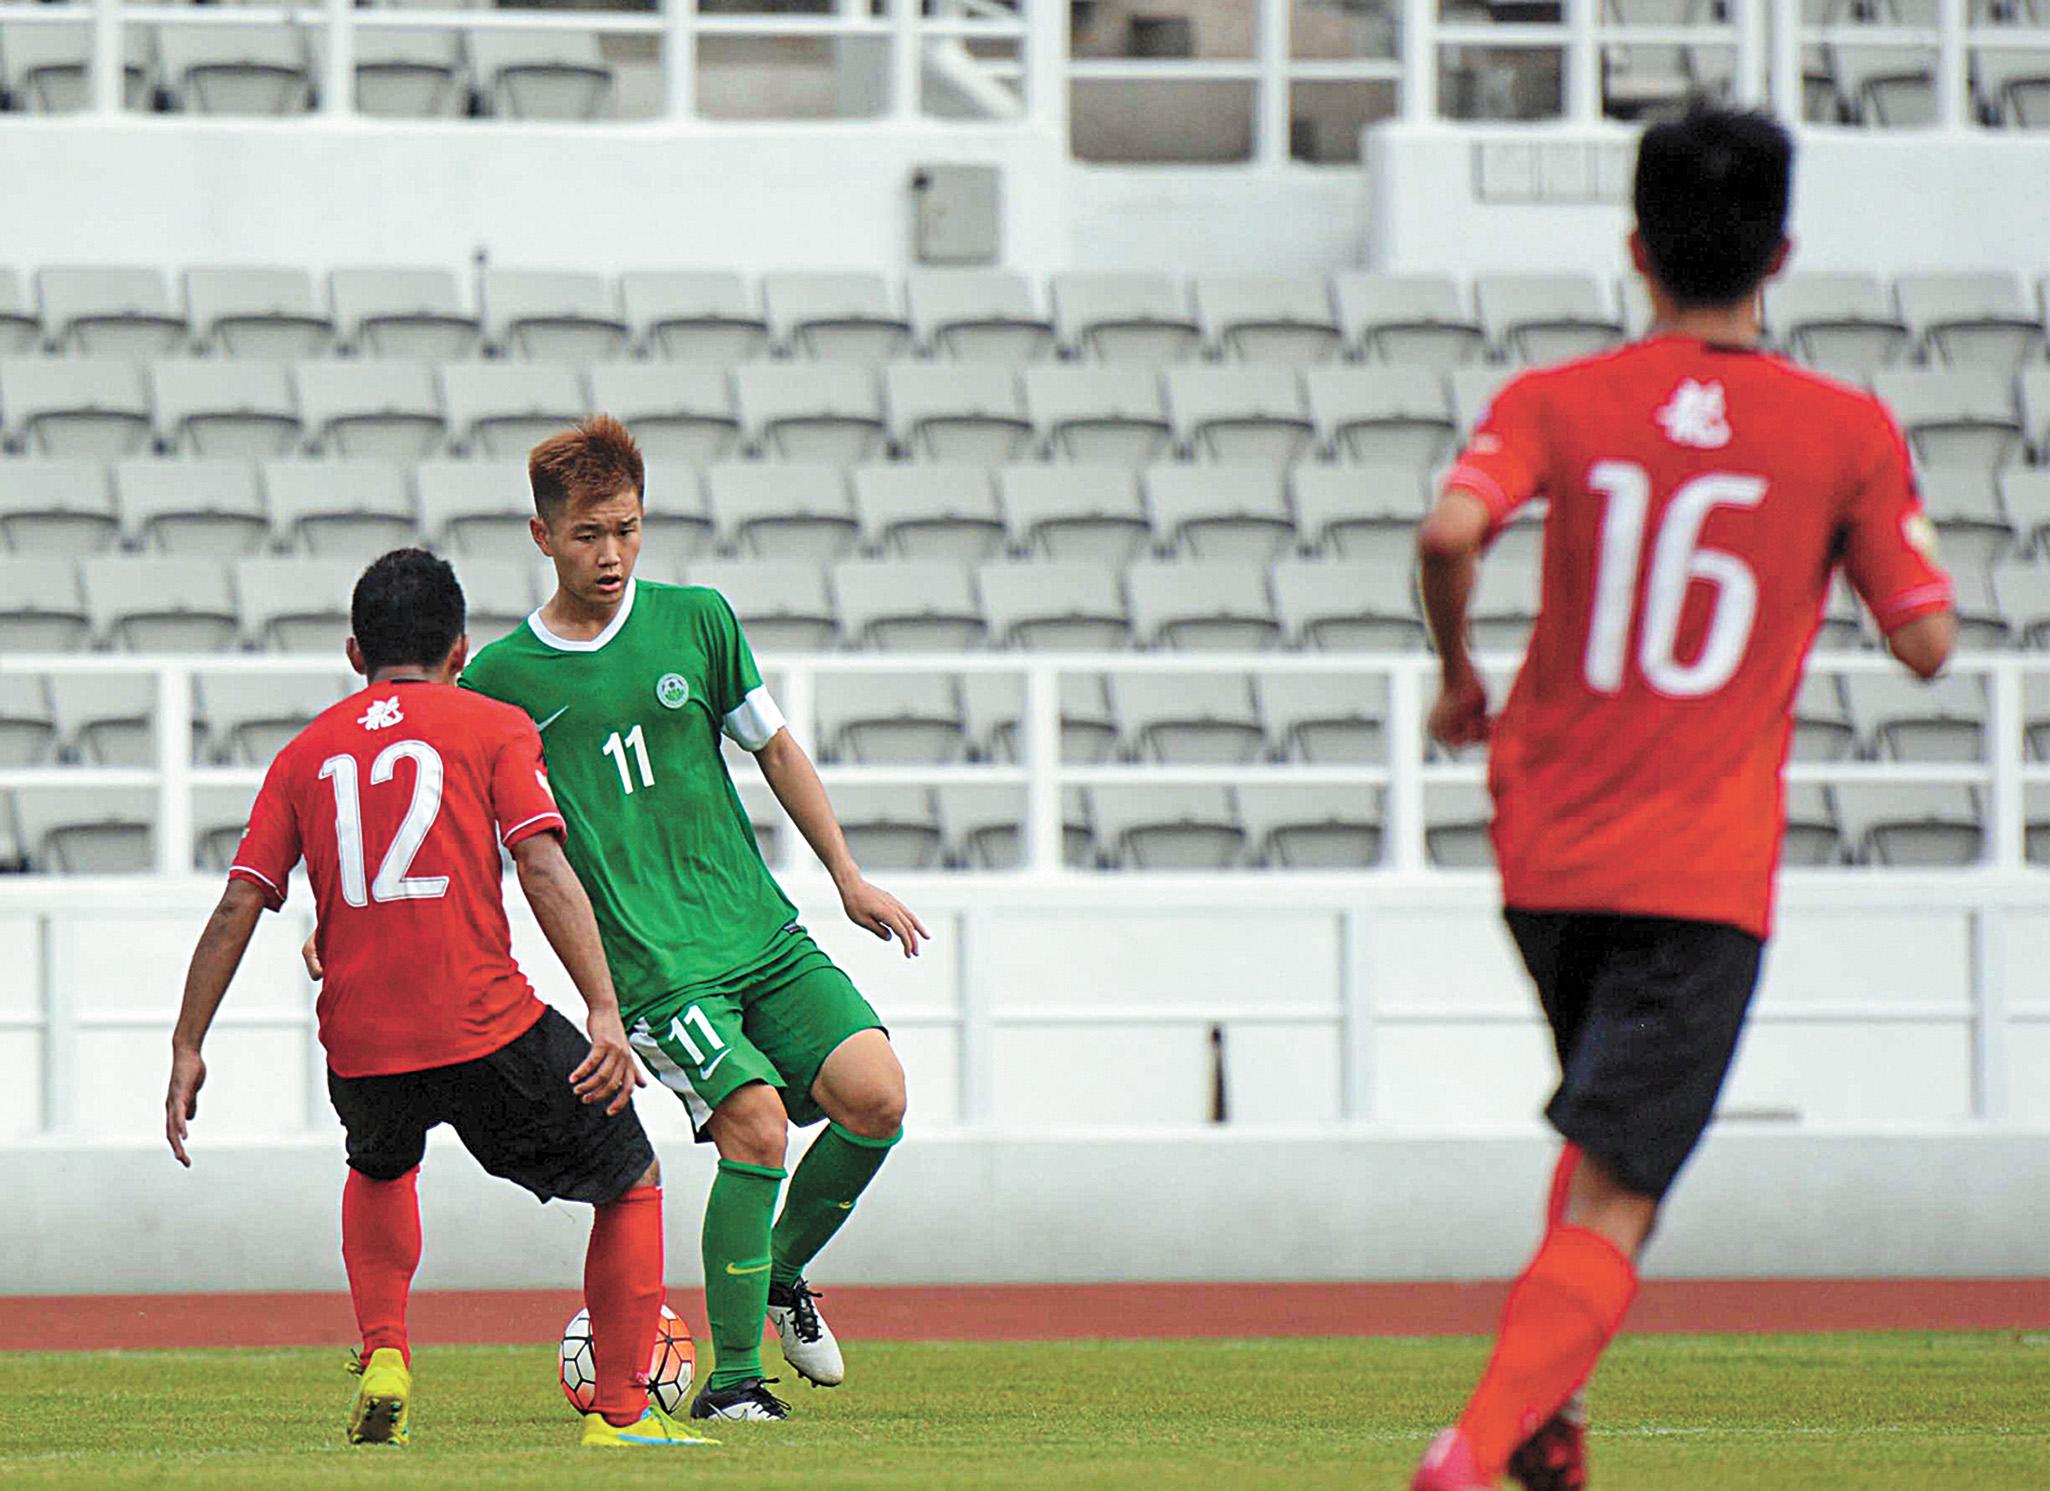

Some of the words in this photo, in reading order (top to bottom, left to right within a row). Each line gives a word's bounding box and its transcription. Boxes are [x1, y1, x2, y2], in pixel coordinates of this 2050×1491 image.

[1584, 460, 1769, 697] 16
[602, 724, 655, 795] 11
[318, 739, 449, 907] 12
[668, 1005, 725, 1065] 11
